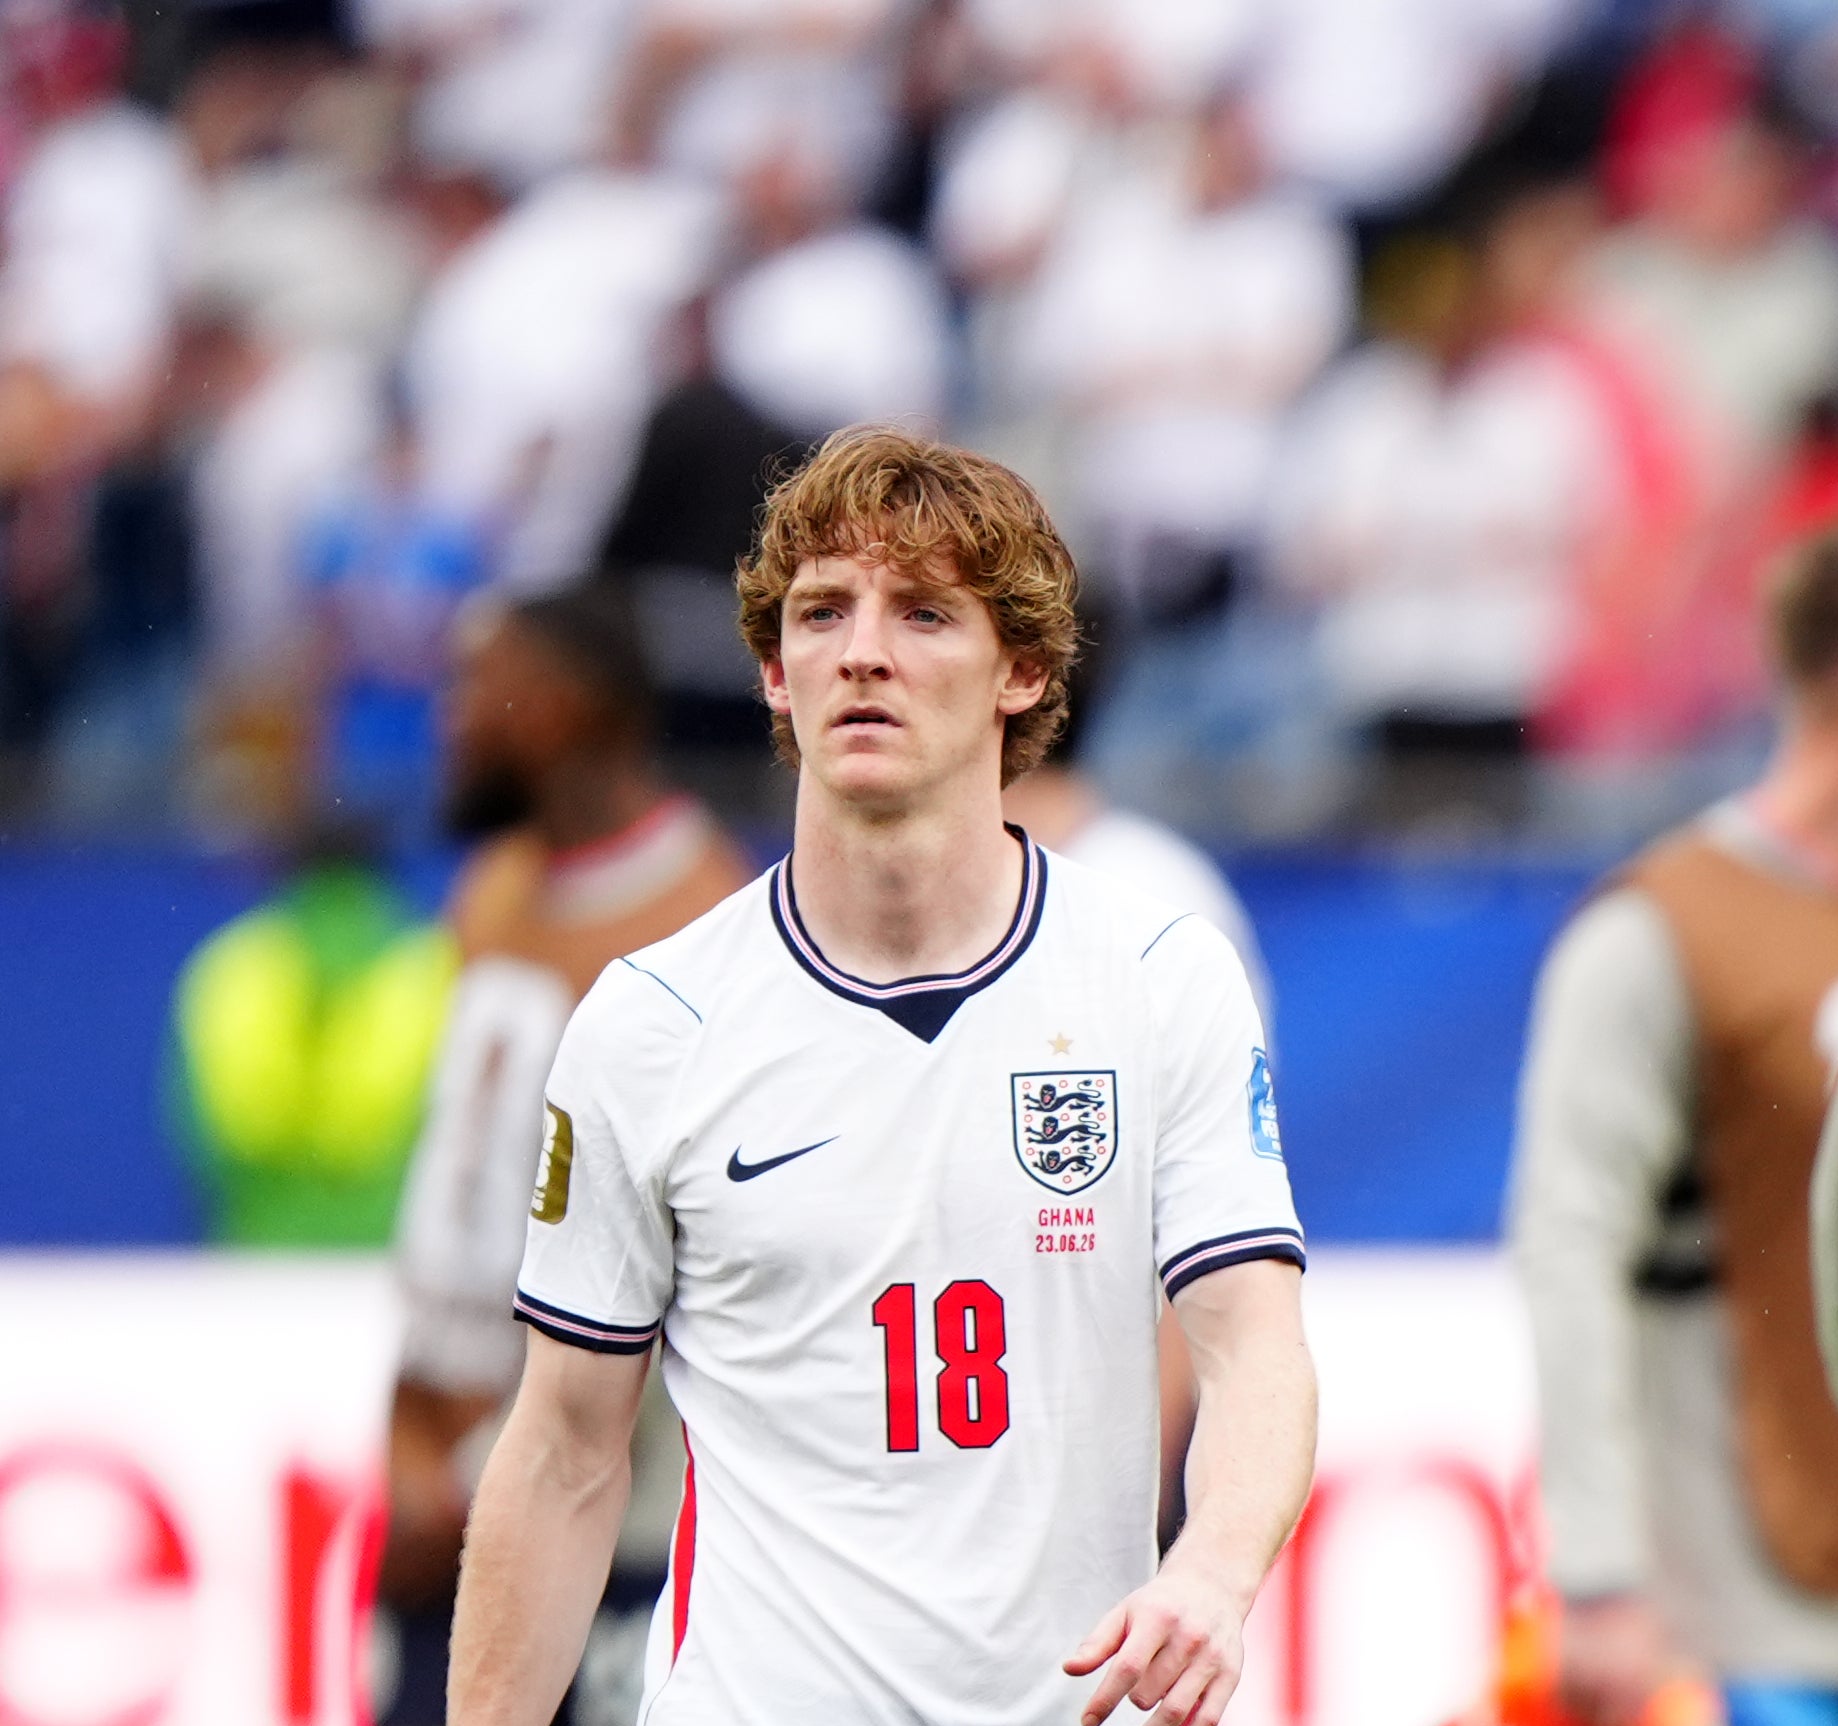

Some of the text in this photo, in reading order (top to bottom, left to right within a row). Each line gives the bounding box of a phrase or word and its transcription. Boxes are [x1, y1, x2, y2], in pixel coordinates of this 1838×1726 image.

[1038, 1207, 1095, 1226] GHANA
[1035, 1233, 1096, 1253] 23.06.26
[872, 1279, 1010, 1452] 18
